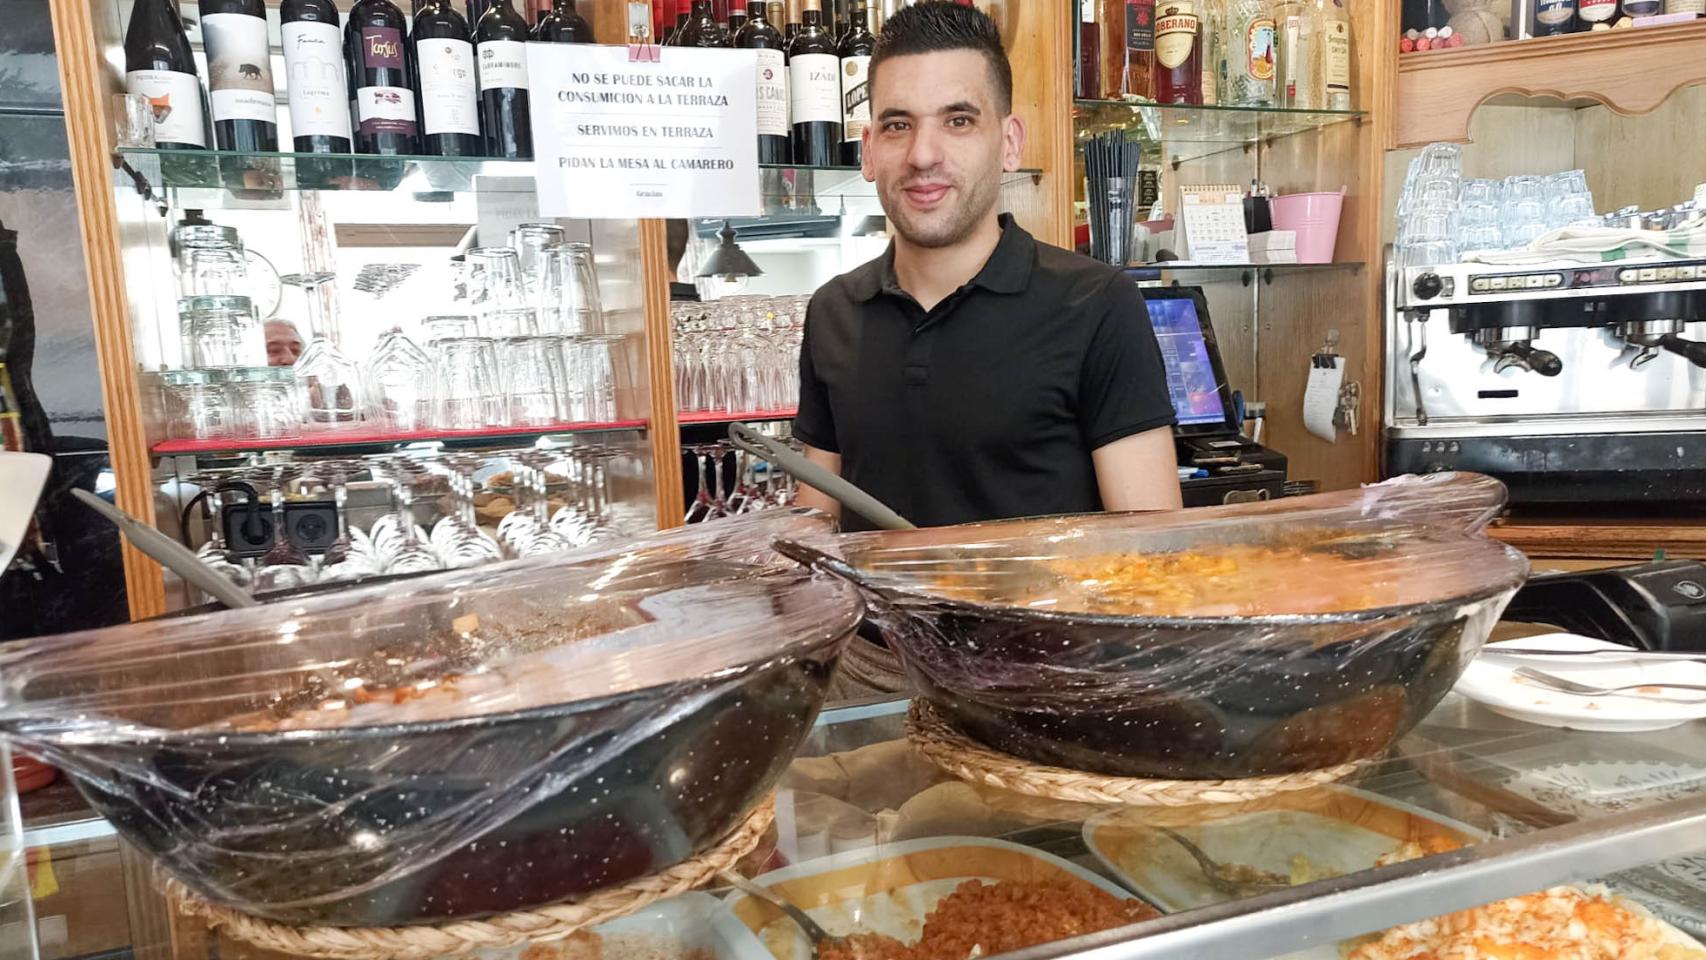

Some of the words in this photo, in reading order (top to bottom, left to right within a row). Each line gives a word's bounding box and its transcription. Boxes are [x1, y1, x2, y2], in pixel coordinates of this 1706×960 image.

[1155, 18, 1196, 32] OBERANO
[572, 73, 590, 85] NO
[593, 73, 609, 85] SE
[613, 74, 653, 86] PUEDE
[656, 75, 695, 88] SACAR
[698, 76, 713, 88] LA
[558, 90, 643, 104] CONSUMICION
[646, 93, 655, 105] A
[658, 94, 673, 105] LA
[677, 95, 728, 106] TERRAZA
[577, 124, 638, 137] SERVIMOS
[642, 126, 657, 137] EN
[661, 127, 713, 138] TERRAZA
[559, 157, 595, 168] PIDAN
[600, 157, 615, 168] LA
[618, 158, 649, 169] MESA
[653, 158, 667, 169] AL
[671, 159, 734, 170] CAMARERO
